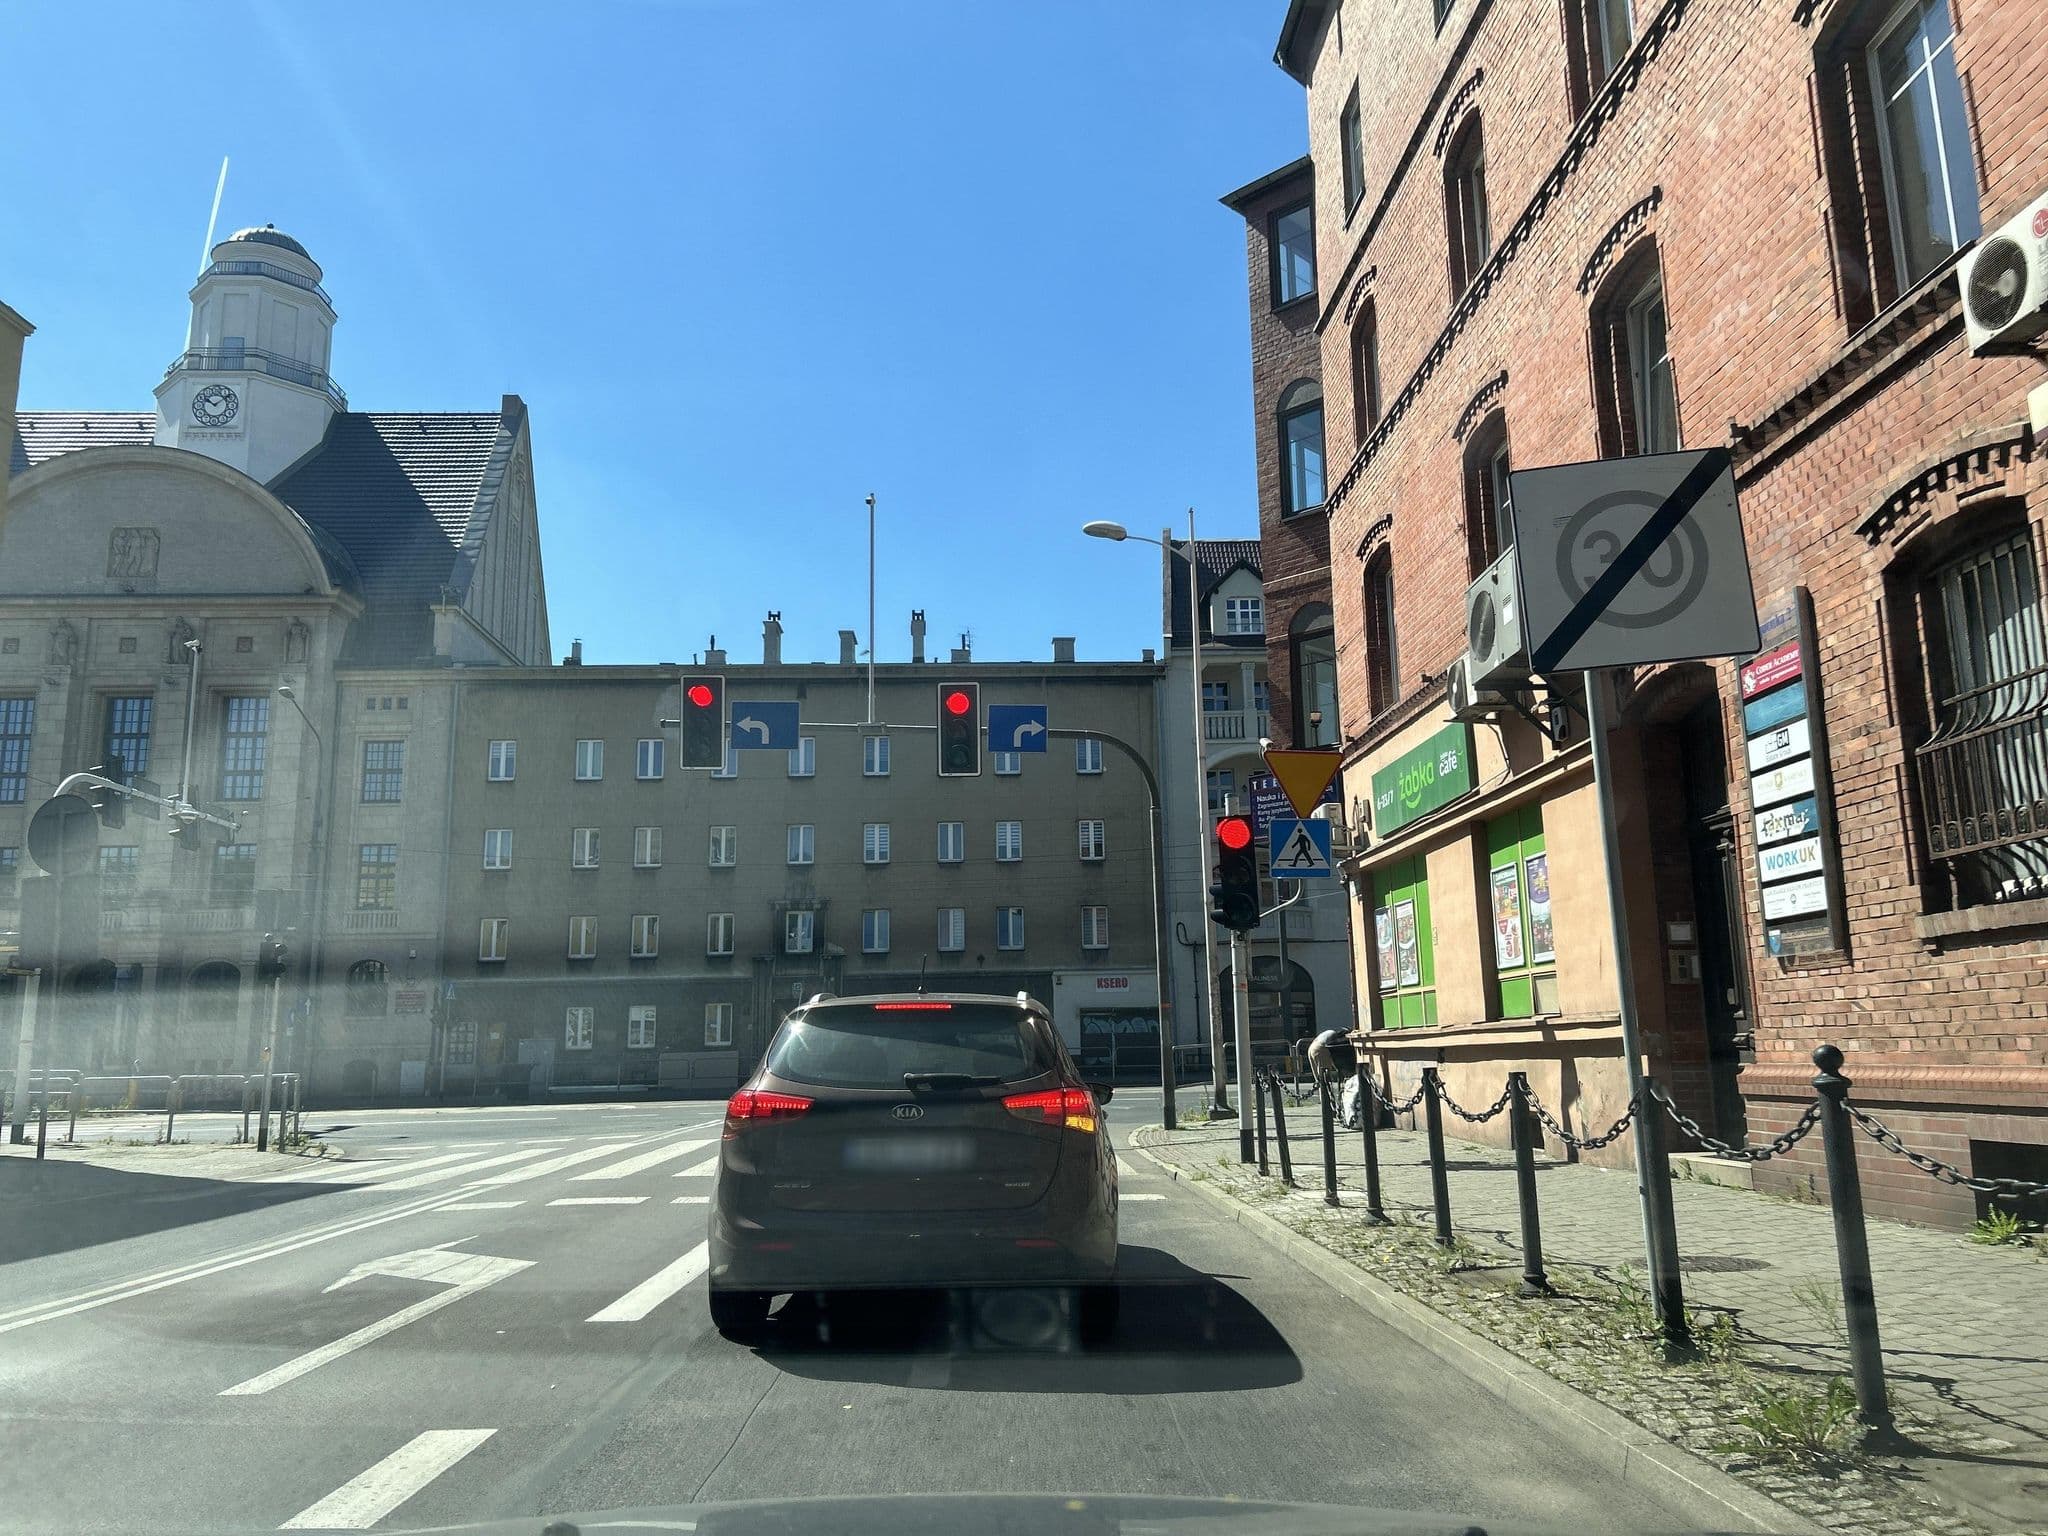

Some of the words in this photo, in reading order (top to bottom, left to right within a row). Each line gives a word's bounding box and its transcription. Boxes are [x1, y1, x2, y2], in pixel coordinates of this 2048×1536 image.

[1399, 760, 1435, 801] żabka
[1439, 749, 1458, 777] café
[1096, 977, 1129, 989] KSERO
[896, 1107, 918, 1118] KIA
